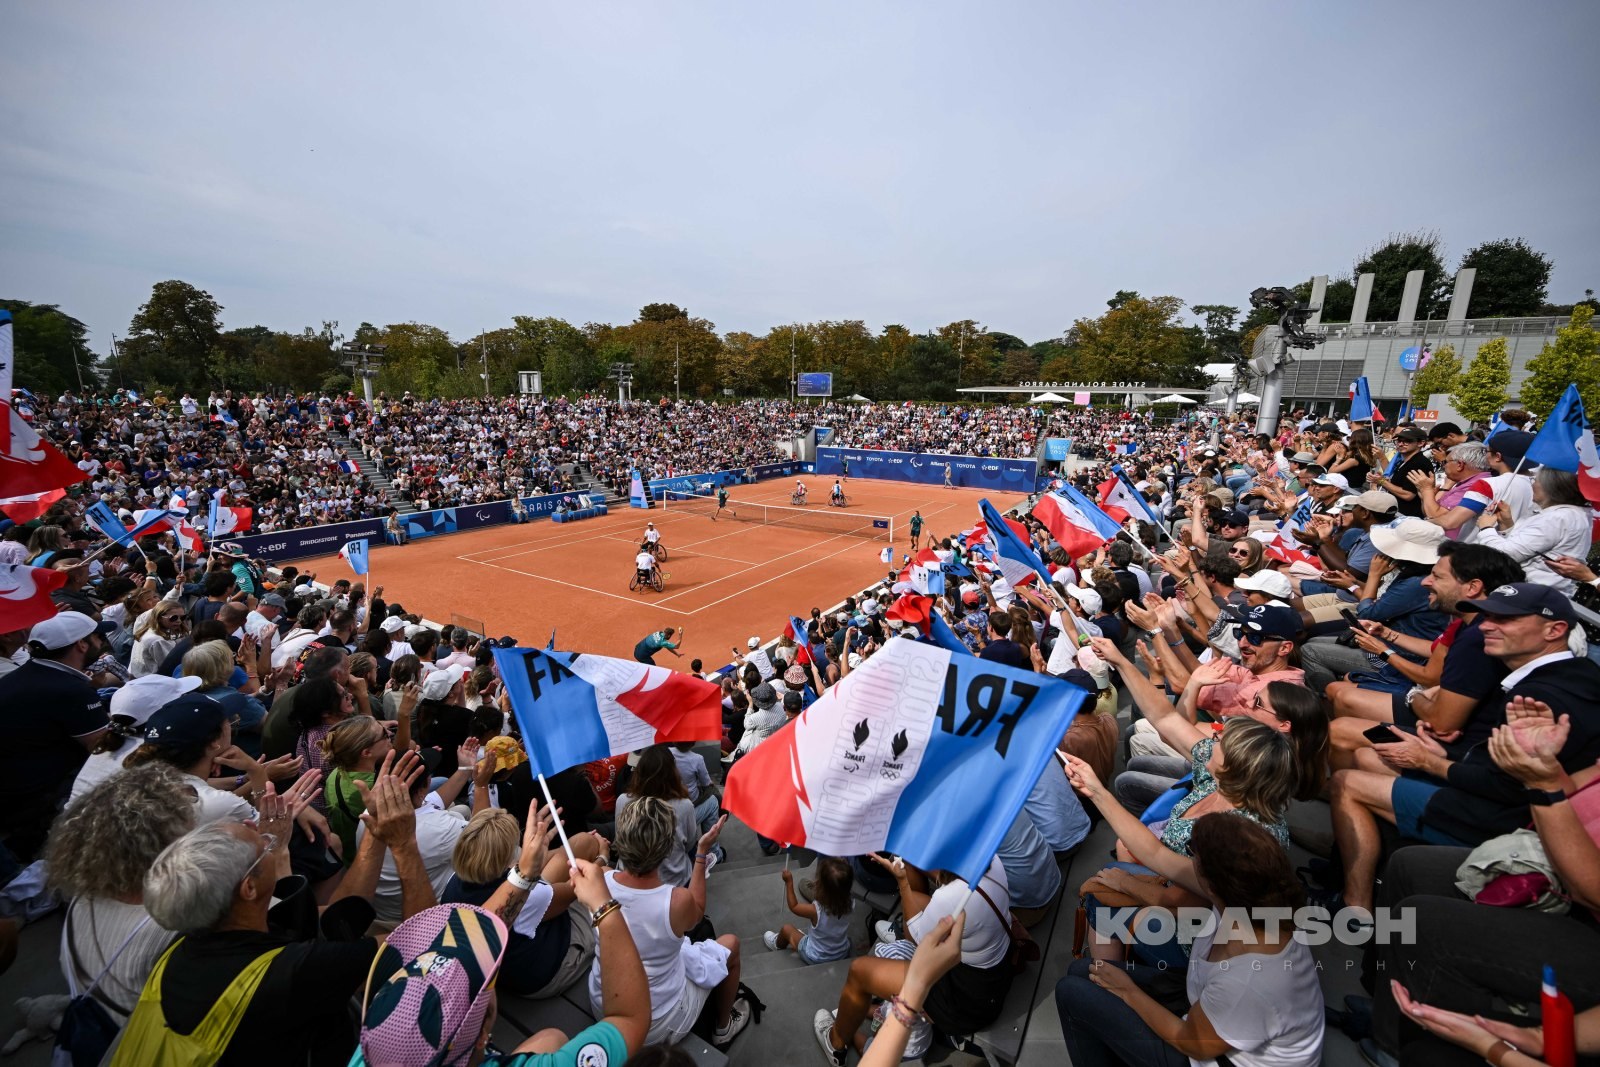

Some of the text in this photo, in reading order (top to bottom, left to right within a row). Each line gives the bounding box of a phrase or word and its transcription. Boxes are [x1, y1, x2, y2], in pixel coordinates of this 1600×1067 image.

[1423, 411, 1435, 419] 14
[345, 530, 377, 539] Panasonic
[300, 535, 338, 546] BRIDGESTONE
